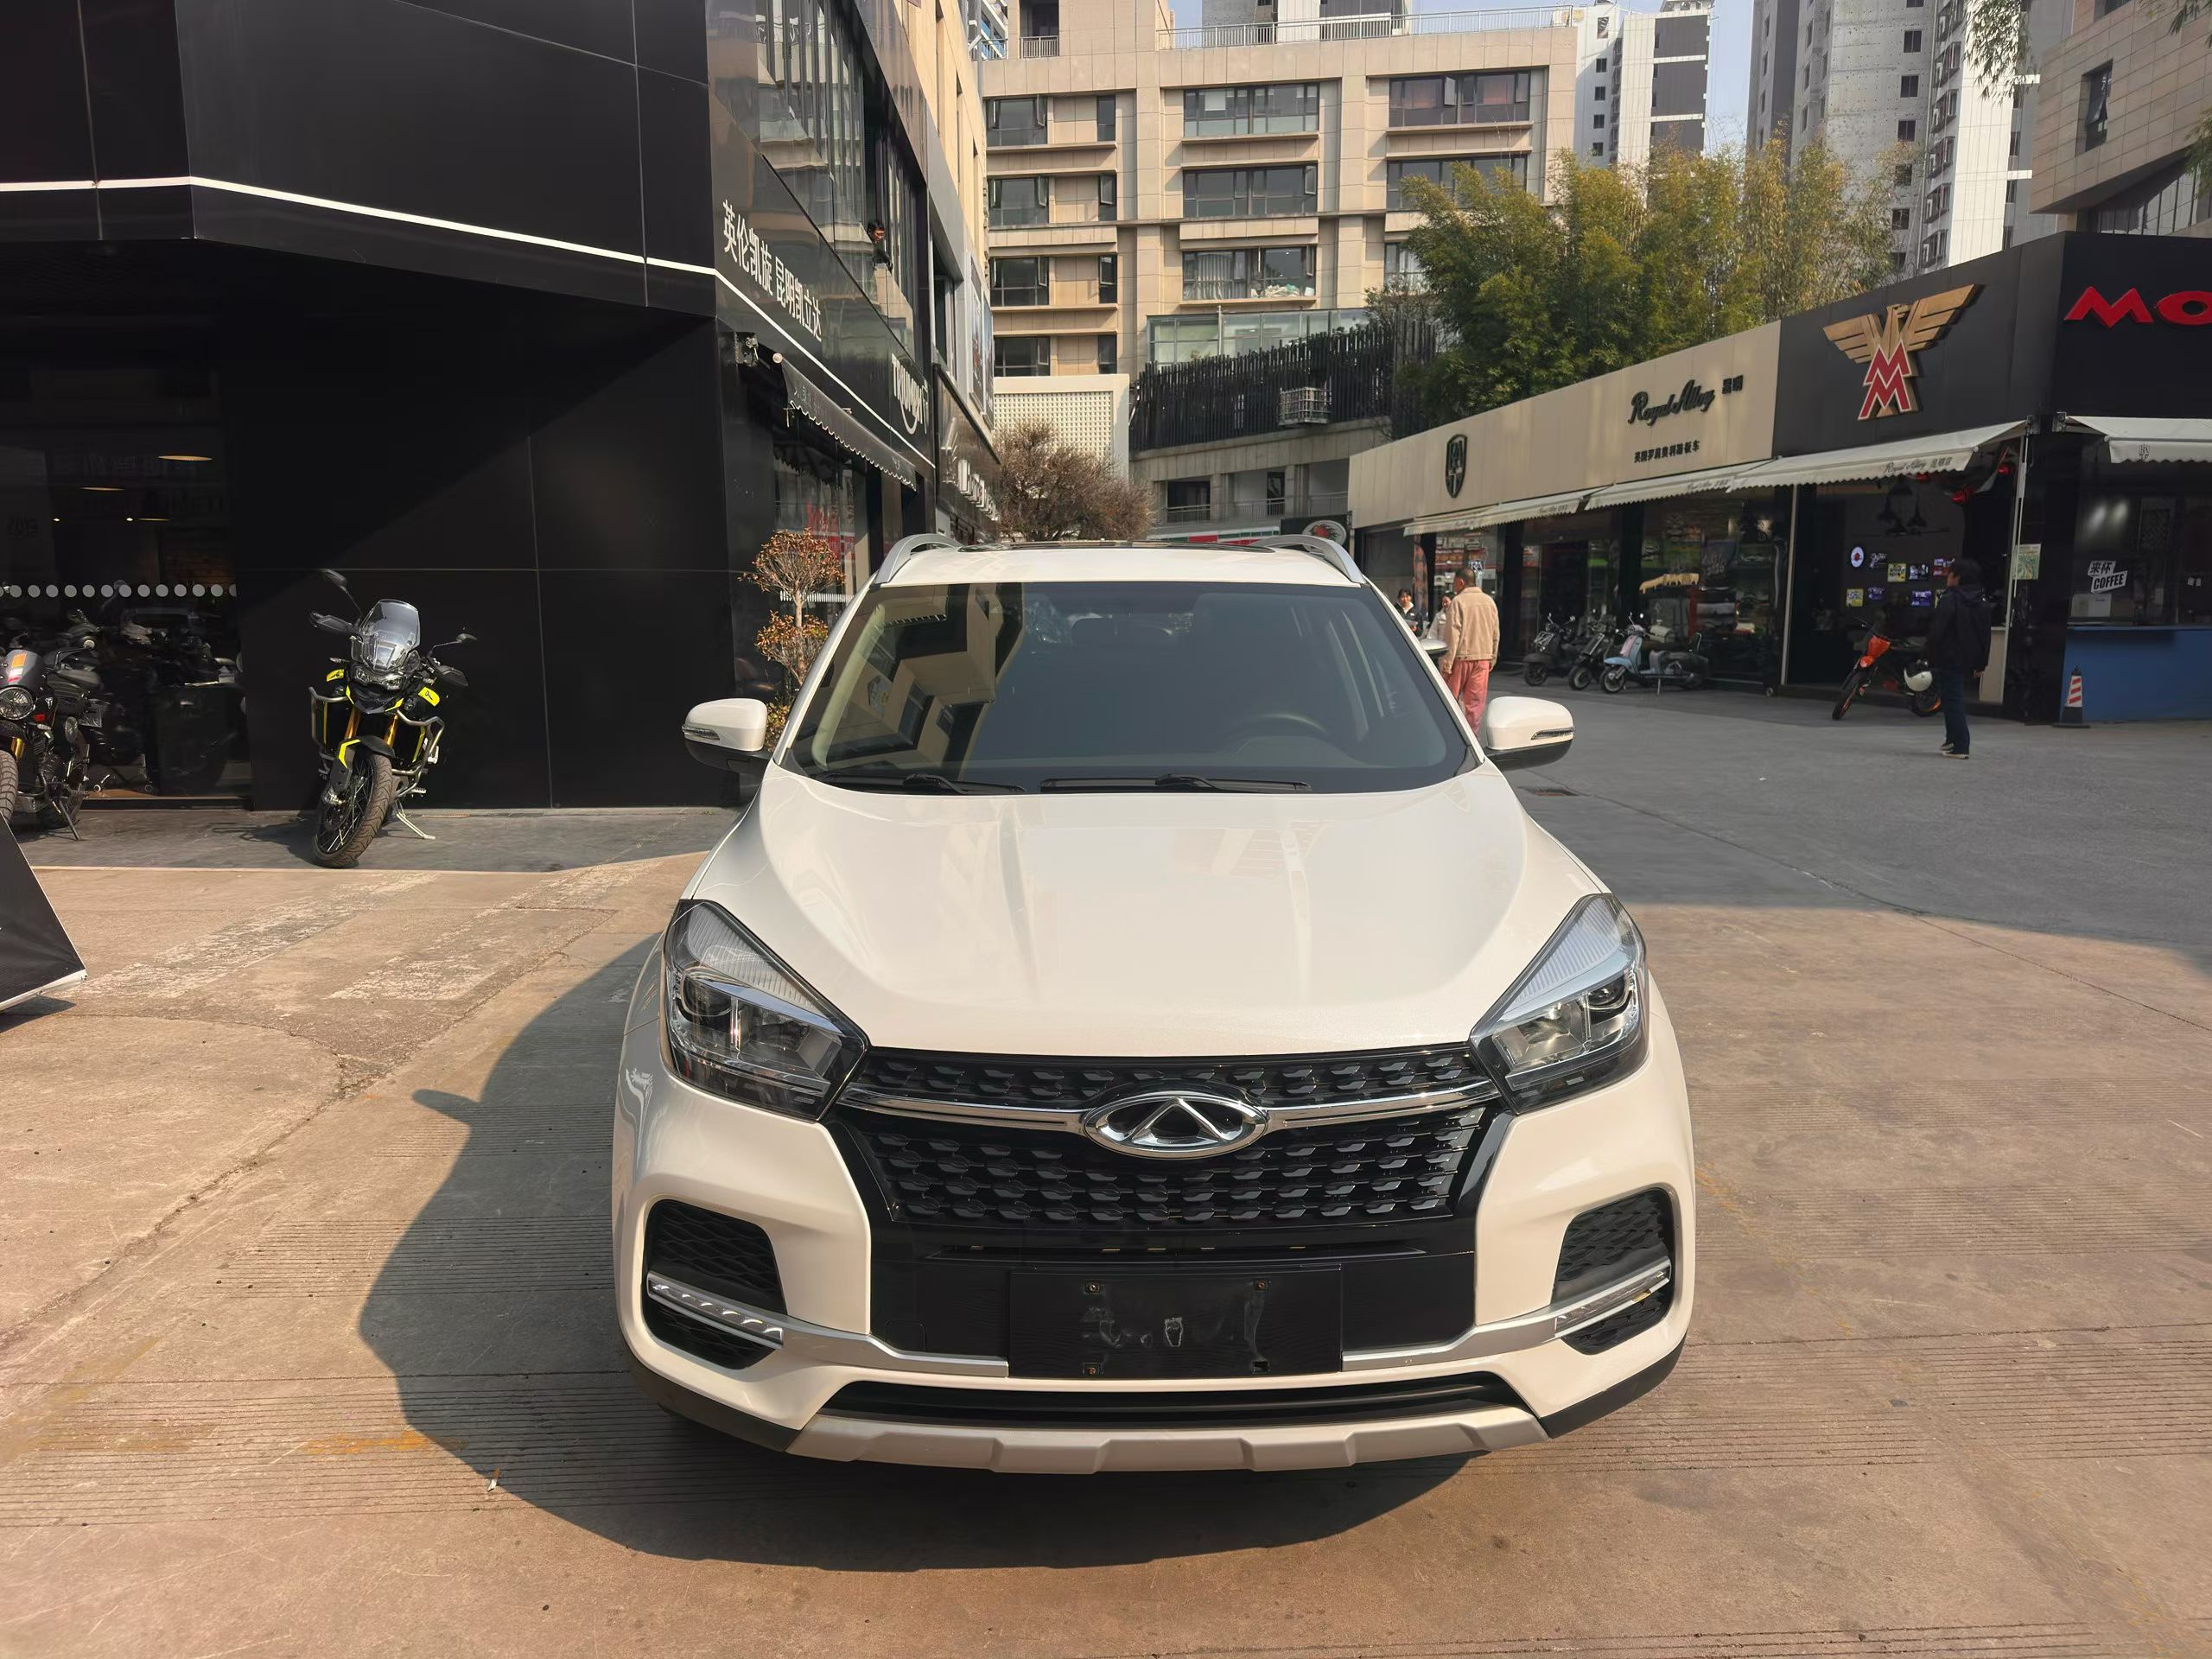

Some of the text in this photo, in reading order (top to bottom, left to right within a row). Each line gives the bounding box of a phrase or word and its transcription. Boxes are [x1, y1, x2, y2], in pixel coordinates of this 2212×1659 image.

[723, 199, 772, 296] 英伦凯旋
[775, 256, 822, 342] 昆明凯立达
[1628, 391, 1675, 426] Royal
[1672, 378, 1716, 413] Alloy
[2093, 573, 2124, 590] COFFEE
